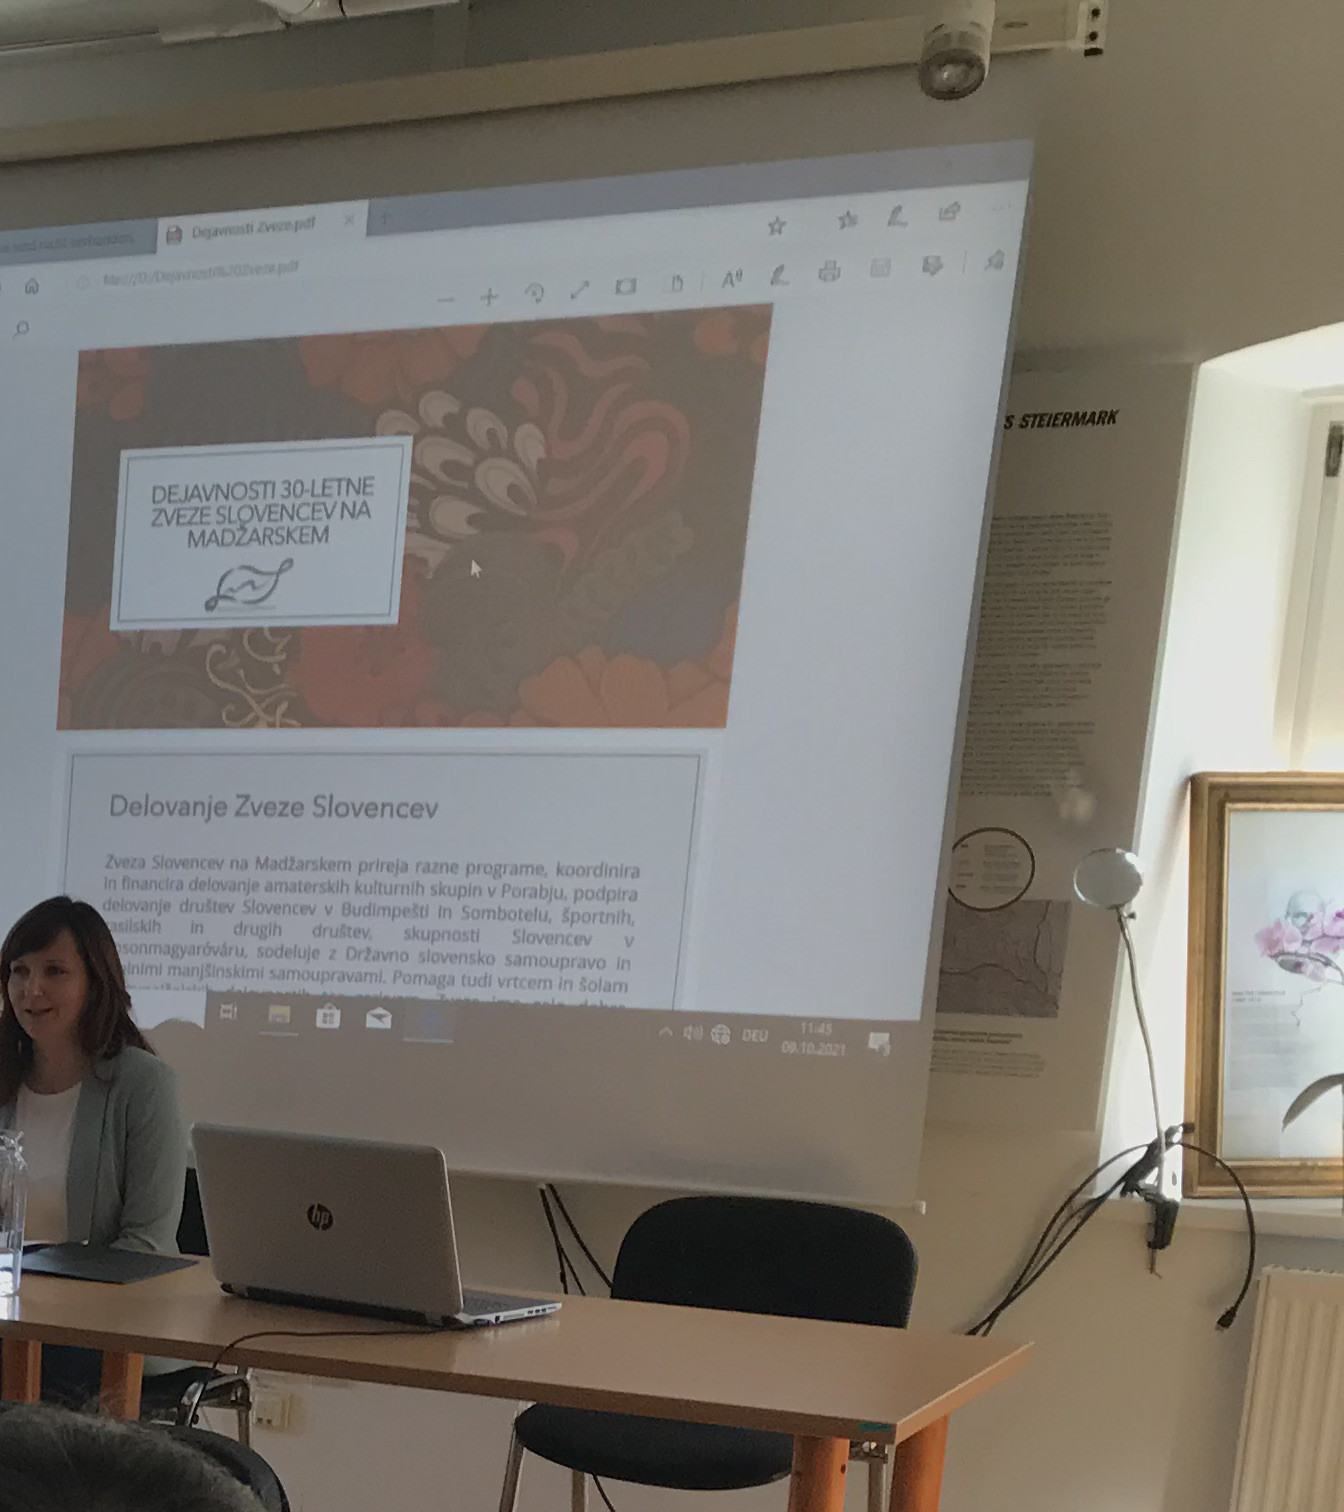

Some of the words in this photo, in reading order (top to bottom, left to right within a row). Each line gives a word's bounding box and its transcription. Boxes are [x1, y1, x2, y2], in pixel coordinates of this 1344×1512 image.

[1018, 408, 1121, 430] STEIERMARK
[151, 480, 276, 505] DEJAVNOSTI
[280, 475, 375, 500] 30-LETNE
[151, 505, 211, 528] ZVEZE
[215, 501, 338, 526] SLOVENCEV
[340, 499, 372, 520] NA
[187, 523, 330, 549] MADŽARSKEM
[110, 793, 228, 824] Delovanje
[234, 794, 304, 818] Zveze
[311, 793, 439, 819] Slovencev
[104, 853, 146, 870] Zveza
[151, 854, 224, 871] Slovencev
[230, 858, 248, 871] na
[254, 856, 352, 873] Madžarskem
[358, 857, 409, 878] prireja
[415, 861, 459, 875] razne
[556, 861, 640, 879] koordinira
[103, 876, 117, 891] in
[121, 875, 184, 892] financira
[188, 876, 260, 896] delovanje
[264, 878, 350, 896] amaterskih
[354, 879, 425, 897] kulturnih
[430, 881, 482, 901] skupin
[487, 886, 497, 898] v
[573, 885, 638, 905] podpira
[102, 898, 171, 917] delovanje
[179, 898, 235, 914] društev
[242, 899, 317, 916] Slovencev
[324, 905, 333, 916] v
[341, 901, 429, 922] Budimpešti
[438, 904, 452, 920] in
[461, 904, 552, 924] Sombotelu,
[108, 917, 161, 934] asilskih
[190, 920, 204, 935] in
[233, 921, 282, 940] drugih
[403, 925, 480, 945] skupnosti
[512, 928, 592, 947] Slovencev
[624, 935, 635, 948] v
[256, 943, 320, 963] sodeluje
[328, 948, 337, 961] z
[345, 945, 410, 963] Državno
[418, 948, 496, 967] slovensko
[504, 953, 607, 973] samoupravo
[616, 956, 631, 971] in
[167, 962, 265, 982] manjšinskimi
[269, 967, 386, 985] samoupravami.
[392, 969, 455, 991] Pomaga
[461, 972, 493, 988] tudi
[497, 975, 553, 990] vrtcem
[558, 976, 574, 991] in
[579, 975, 629, 994] šolam
[741, 1028, 769, 1043] DEU
